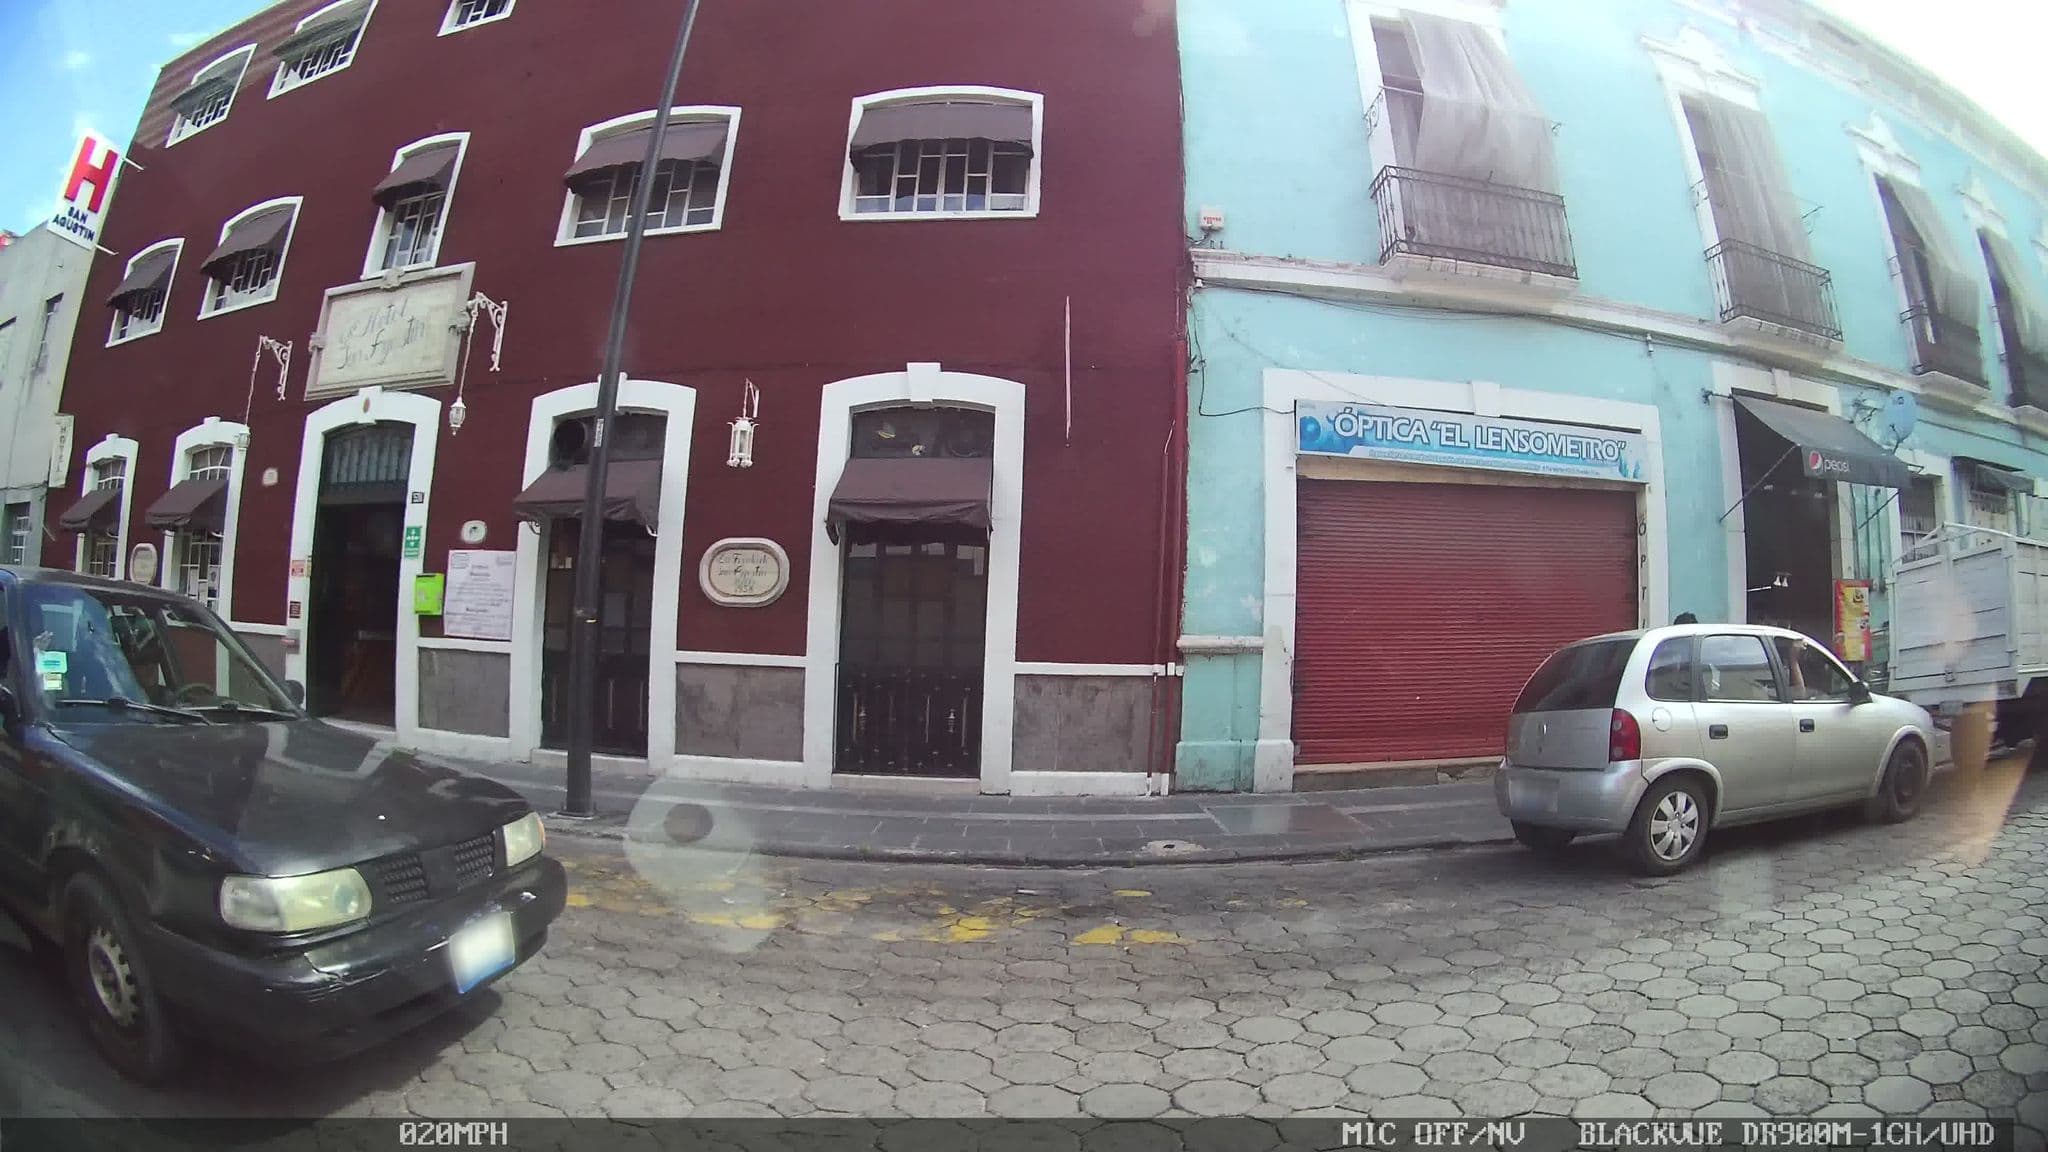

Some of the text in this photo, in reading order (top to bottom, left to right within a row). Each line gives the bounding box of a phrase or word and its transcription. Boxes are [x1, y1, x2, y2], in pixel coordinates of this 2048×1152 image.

[64, 136, 118, 214] H
[52, 214, 96, 242] AGUSTIN
[68, 206, 89, 225] SAN
[1334, 406, 1431, 445] ÓPTICA
